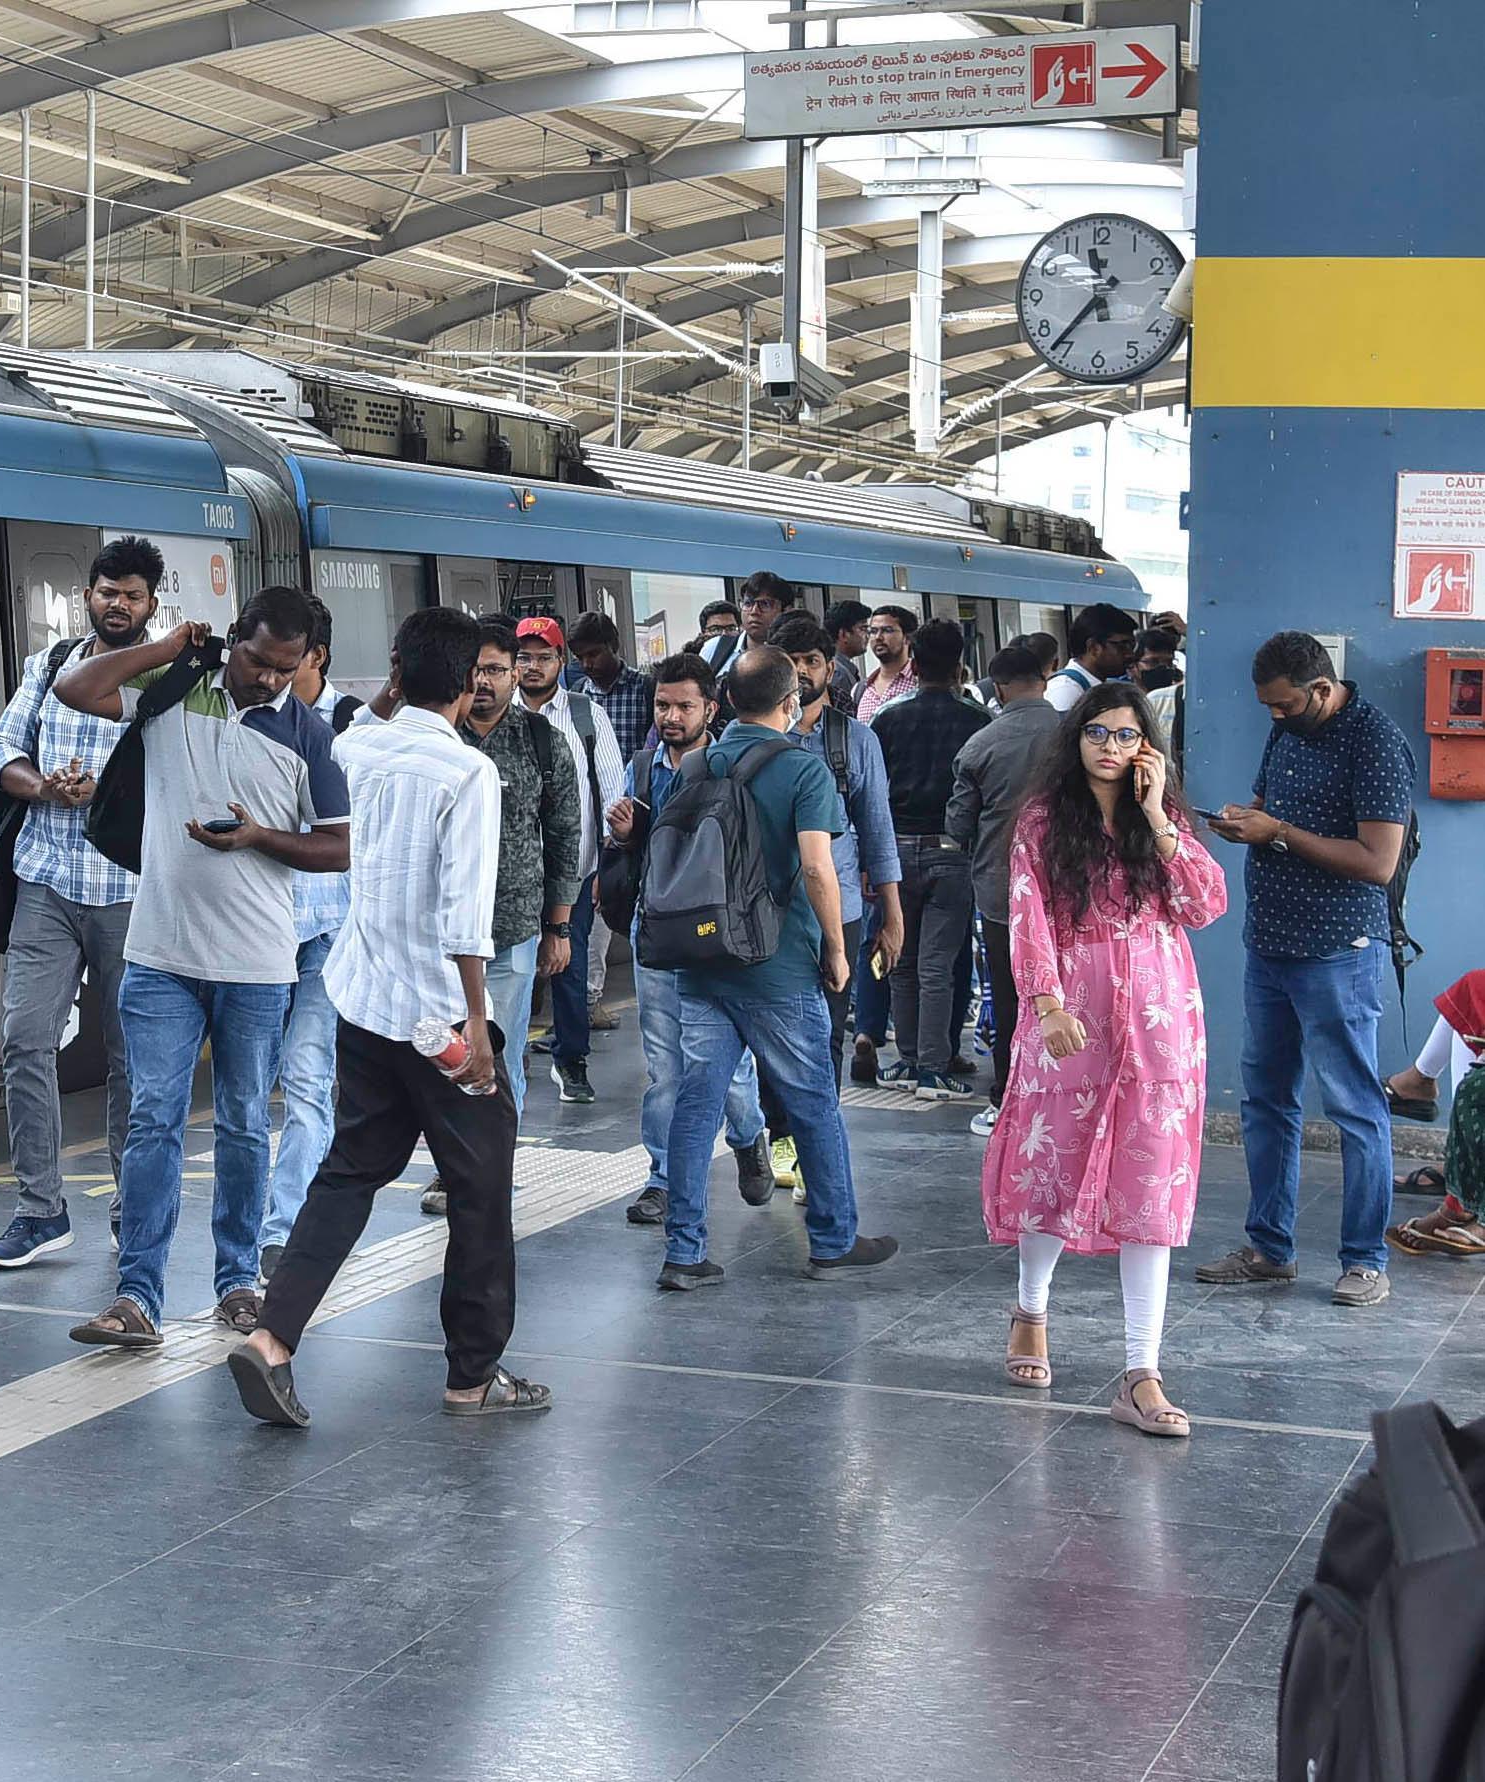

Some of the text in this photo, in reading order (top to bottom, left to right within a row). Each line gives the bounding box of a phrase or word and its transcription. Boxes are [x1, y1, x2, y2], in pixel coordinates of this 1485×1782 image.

[805, 54, 868, 71] సమయంలో
[828, 65, 1025, 86] Push to stop train in Emergency
[862, 92, 874, 105] के
[880, 90, 901, 105] लिए
[907, 91, 940, 103] आपात
[946, 85, 976, 100] स्थिति
[983, 83, 991, 98] में
[1065, 236, 1079, 254] 11
[1093, 226, 1110, 245] 12
[1149, 257, 1164, 275] 2
[1029, 288, 1043, 306] 9
[1037, 319, 1051, 337] 8
[1146, 318, 1162, 337] 4
[1061, 340, 1075, 358] 7
[1126, 340, 1139, 359] 5
[1091, 350, 1105, 369] 6
[202, 502, 235, 529] TA003
[156, 570, 180, 594] ad 8
[320, 560, 380, 589] SAMSUNG
[147, 605, 183, 629] PUTING
